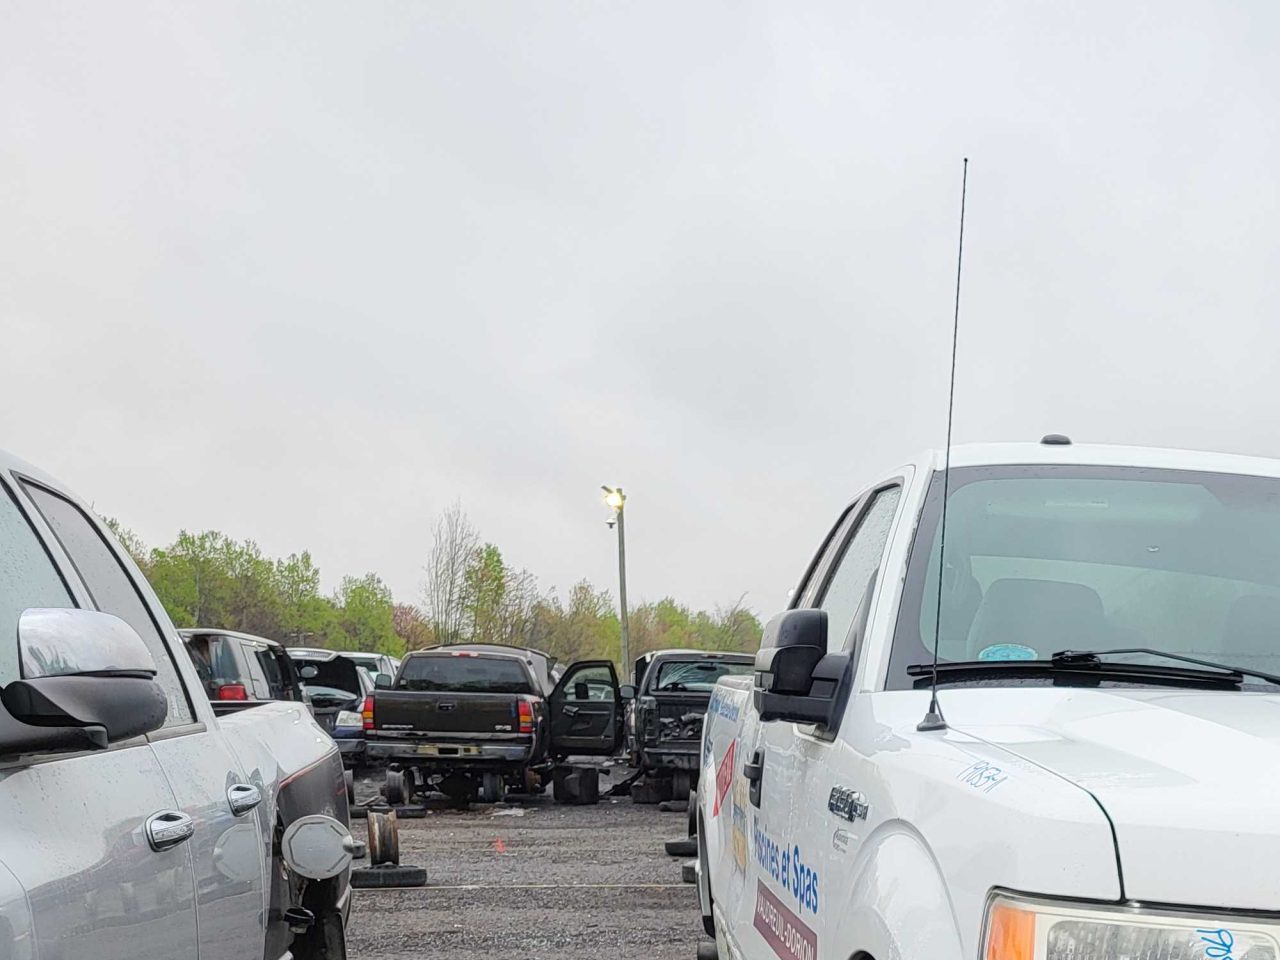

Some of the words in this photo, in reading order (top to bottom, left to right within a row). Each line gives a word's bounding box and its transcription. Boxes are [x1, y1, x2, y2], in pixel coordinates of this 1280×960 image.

[753, 815, 779, 882] Piscines
[781, 843, 790, 891] et
[792, 844, 818, 915] Spas
